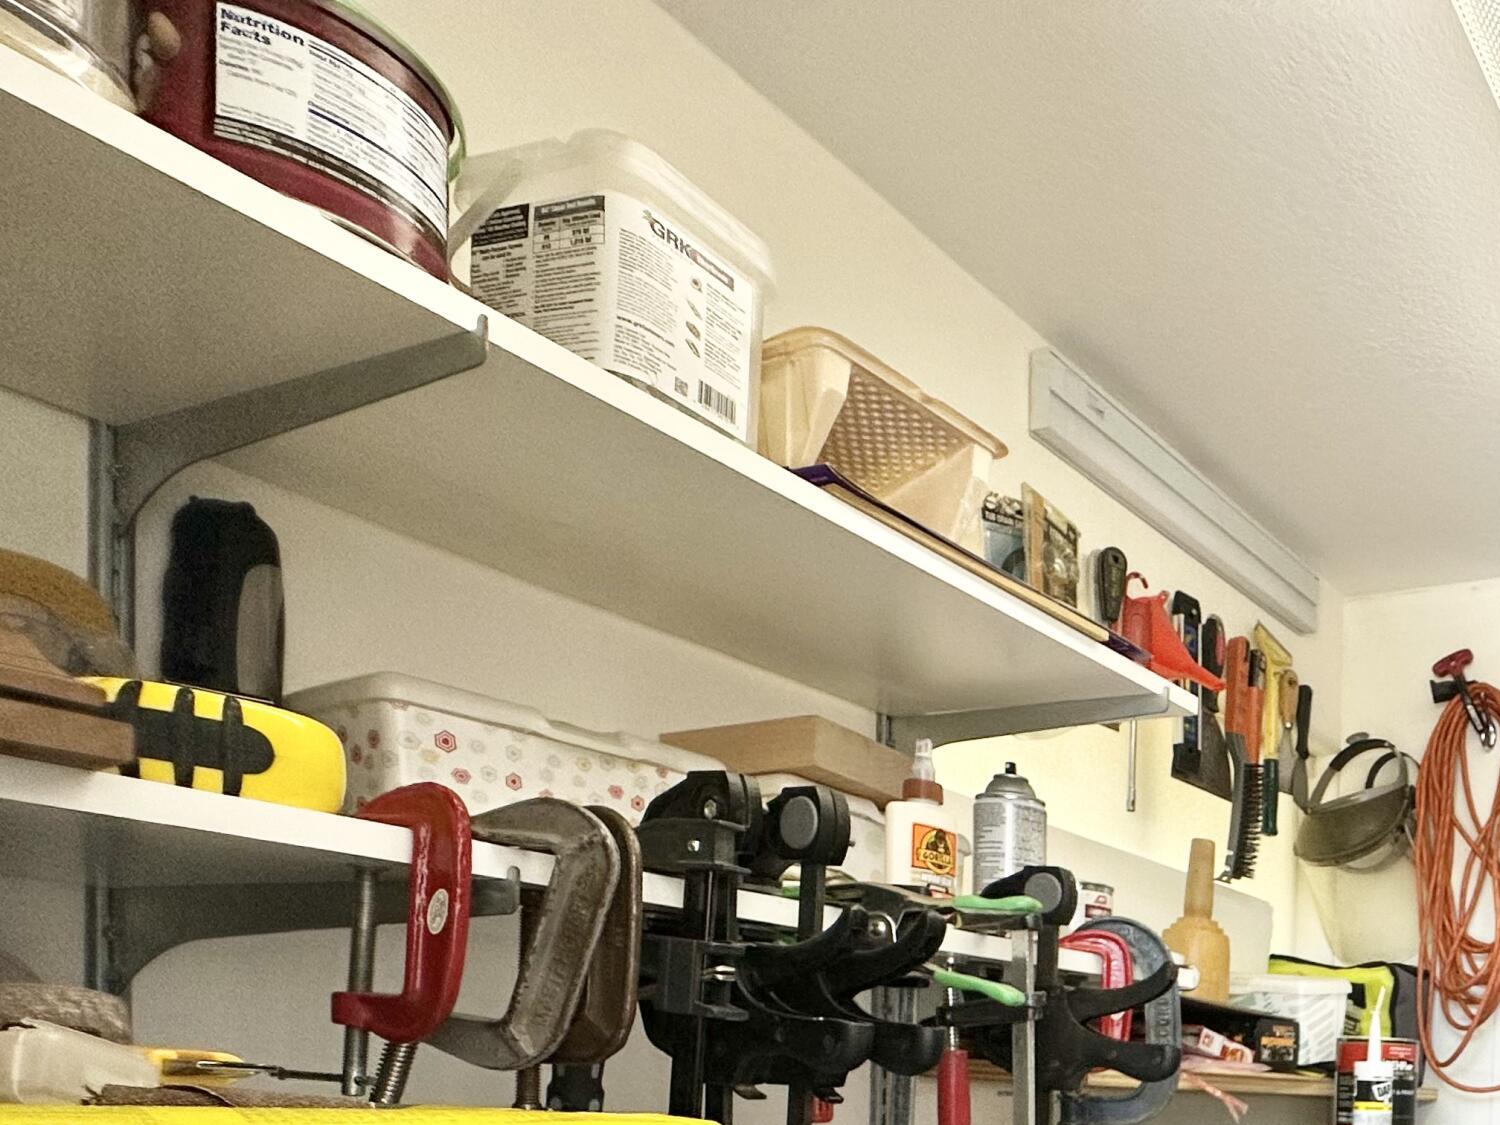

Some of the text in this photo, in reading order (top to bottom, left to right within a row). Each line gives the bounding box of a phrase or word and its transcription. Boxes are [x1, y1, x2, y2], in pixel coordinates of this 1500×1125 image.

[220, 8, 305, 47] Nutrition
[220, 22, 272, 46] Facts
[650, 215, 691, 259] GRK
